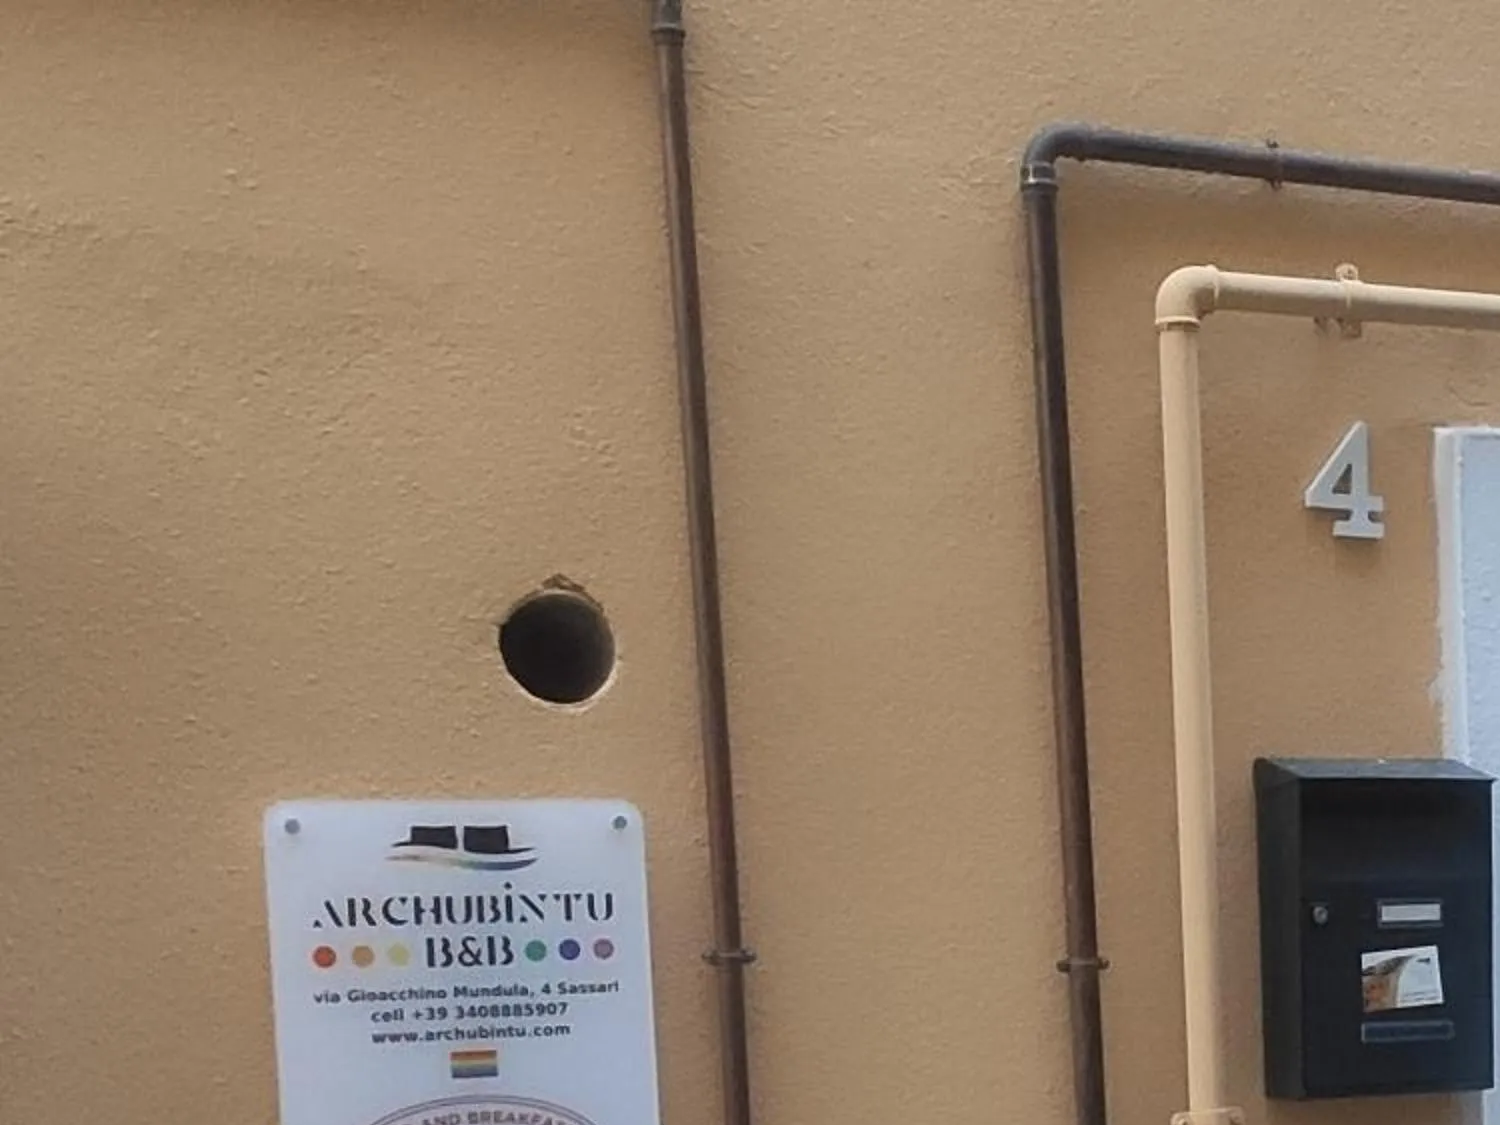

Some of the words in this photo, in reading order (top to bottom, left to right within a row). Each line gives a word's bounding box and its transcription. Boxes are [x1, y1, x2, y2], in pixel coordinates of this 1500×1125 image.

[1304, 420, 1385, 539] 4
[425, 935, 515, 969] B&B
[313, 989, 341, 1004] via
[347, 987, 448, 1003] Gioacchino
[453, 984, 535, 999] Mundula,
[541, 983, 552, 995] 4
[557, 980, 619, 996] Sassari
[371, 1007, 404, 1022] cell
[413, 1005, 448, 1021] +39
[456, 1002, 569, 1019] 3408885907
[371, 1025, 571, 1043] www.archubintu.com
